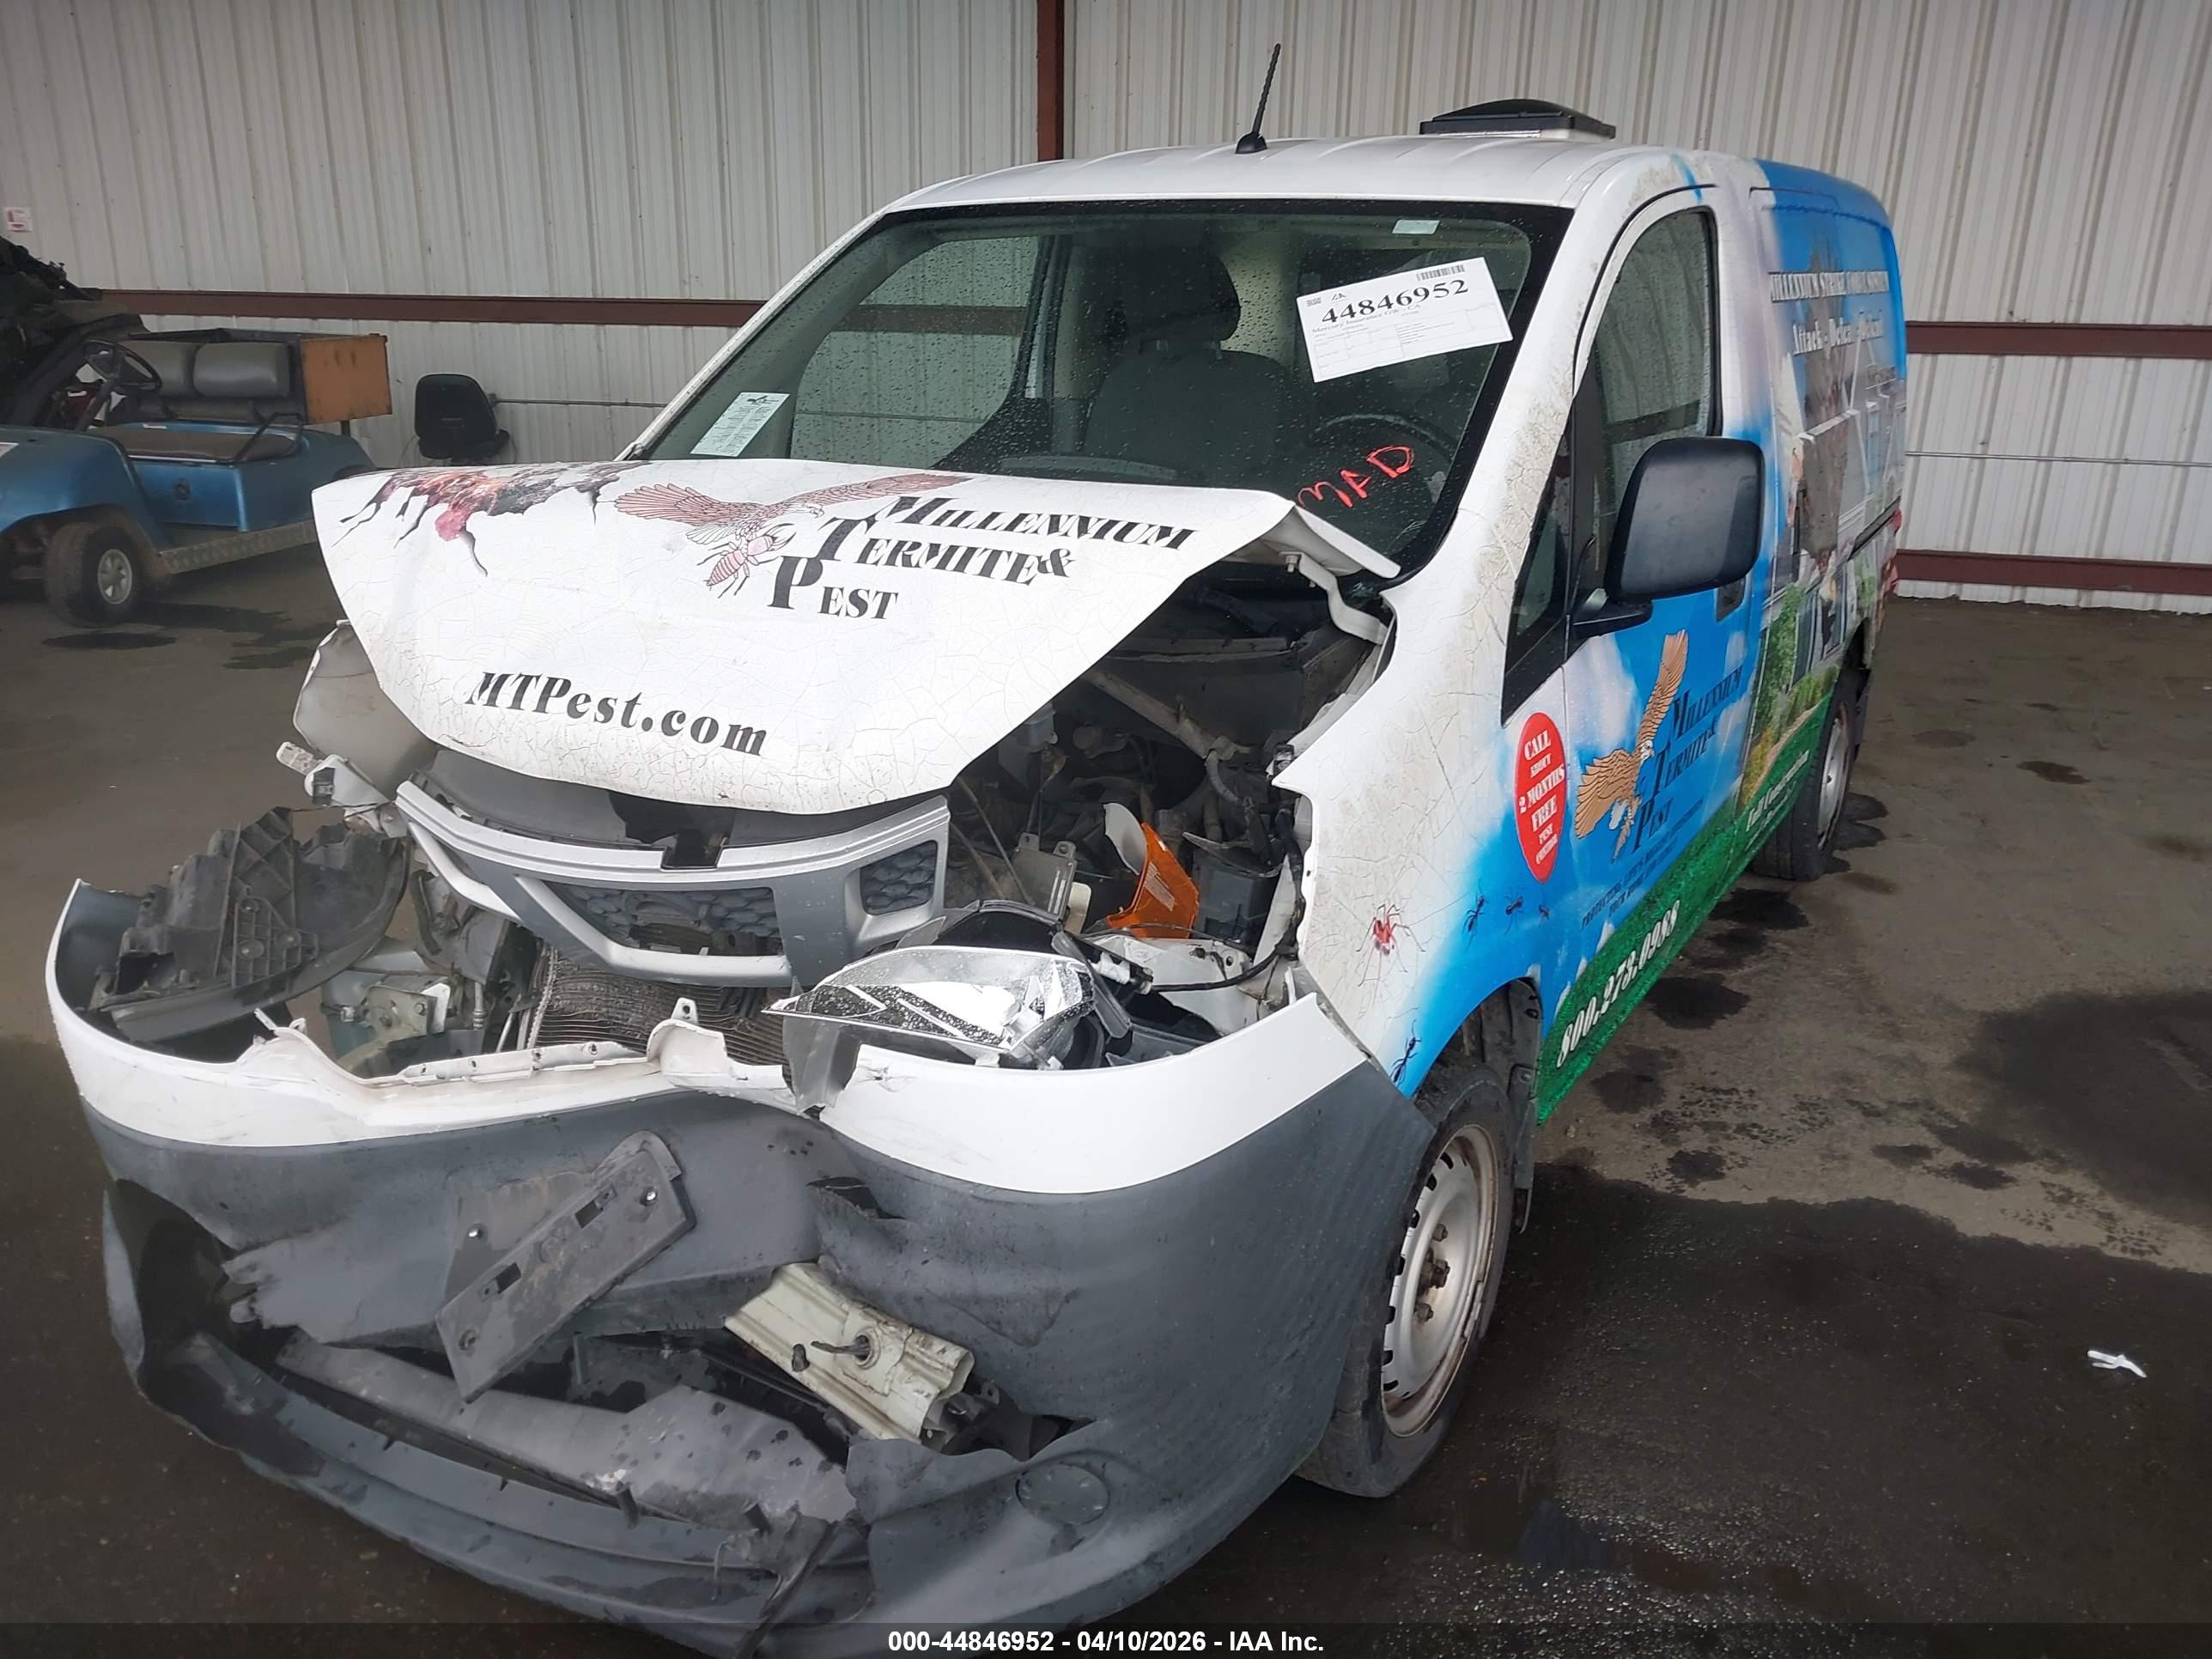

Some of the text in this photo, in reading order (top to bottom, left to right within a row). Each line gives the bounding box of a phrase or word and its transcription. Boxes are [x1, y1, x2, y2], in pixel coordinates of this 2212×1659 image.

[1322, 279, 1469, 323] 44846952
[871, 496, 1200, 550] MILLENNIUM
[767, 555, 899, 619] PEST
[465, 672, 768, 757] MTPest.com
[1524, 729, 1552, 761] CALL
[1518, 795, 1527, 814] 2
